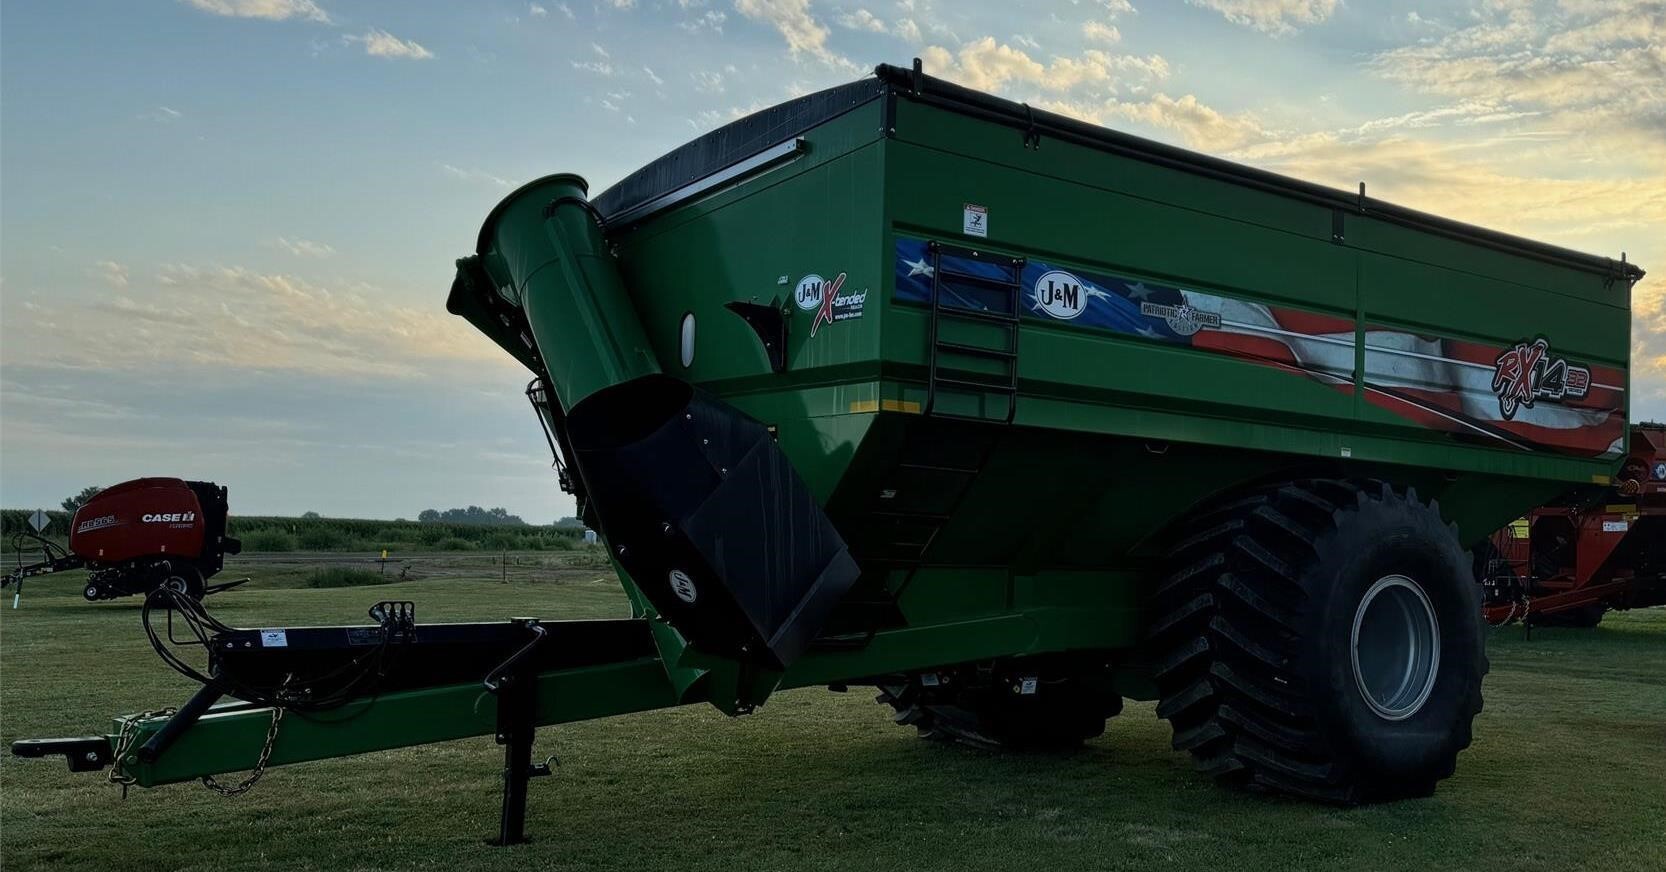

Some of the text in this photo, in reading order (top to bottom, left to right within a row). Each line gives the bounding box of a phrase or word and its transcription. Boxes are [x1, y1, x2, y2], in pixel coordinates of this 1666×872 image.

[799, 281, 821, 303] J&M
[1040, 281, 1079, 310] J&M
[1143, 303, 1218, 325] PATRIOTIC FARMER
[142, 513, 182, 523] CASE
[673, 572, 693, 599] J&M
